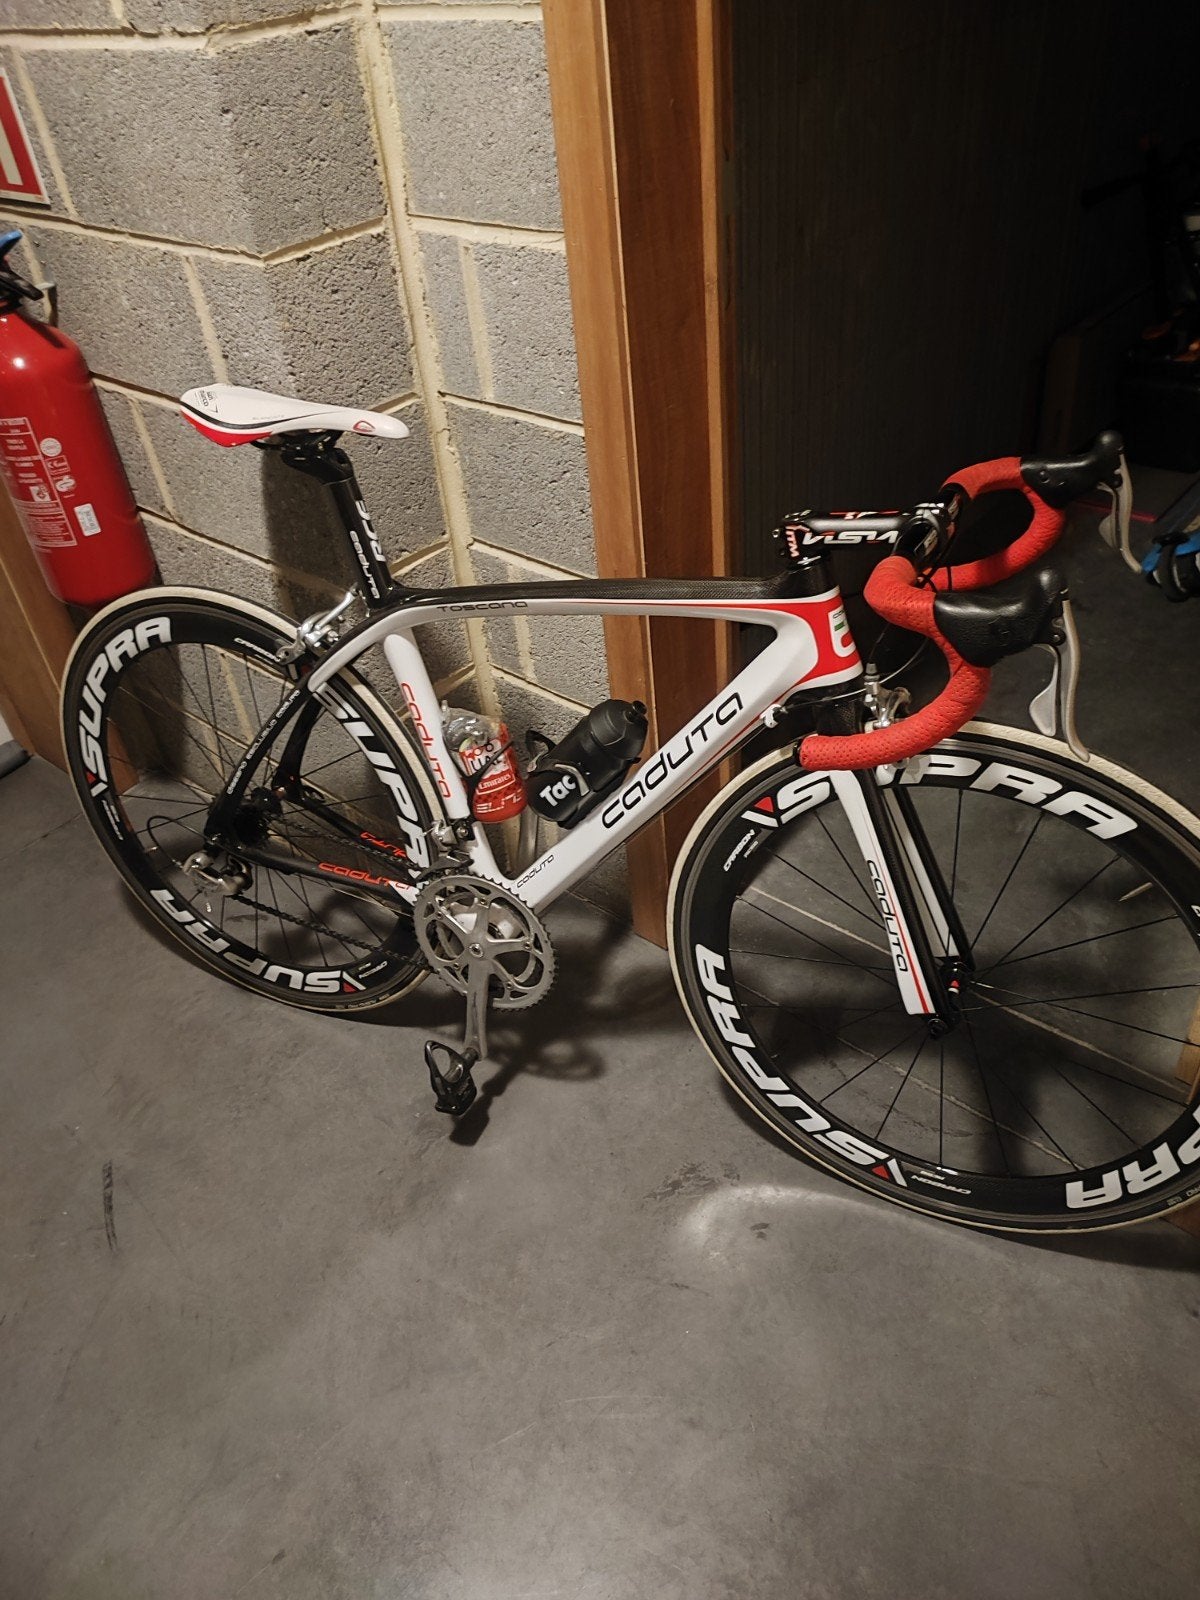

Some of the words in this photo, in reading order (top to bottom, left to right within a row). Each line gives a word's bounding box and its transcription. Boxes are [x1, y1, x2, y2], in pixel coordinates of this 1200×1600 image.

[79, 616, 173, 784] SUPRA
[313, 682, 430, 888] SUPR
[723, 829, 756, 872] CARBON
[151, 889, 342, 993] SUPRA
[695, 943, 890, 1166] SUPRA
